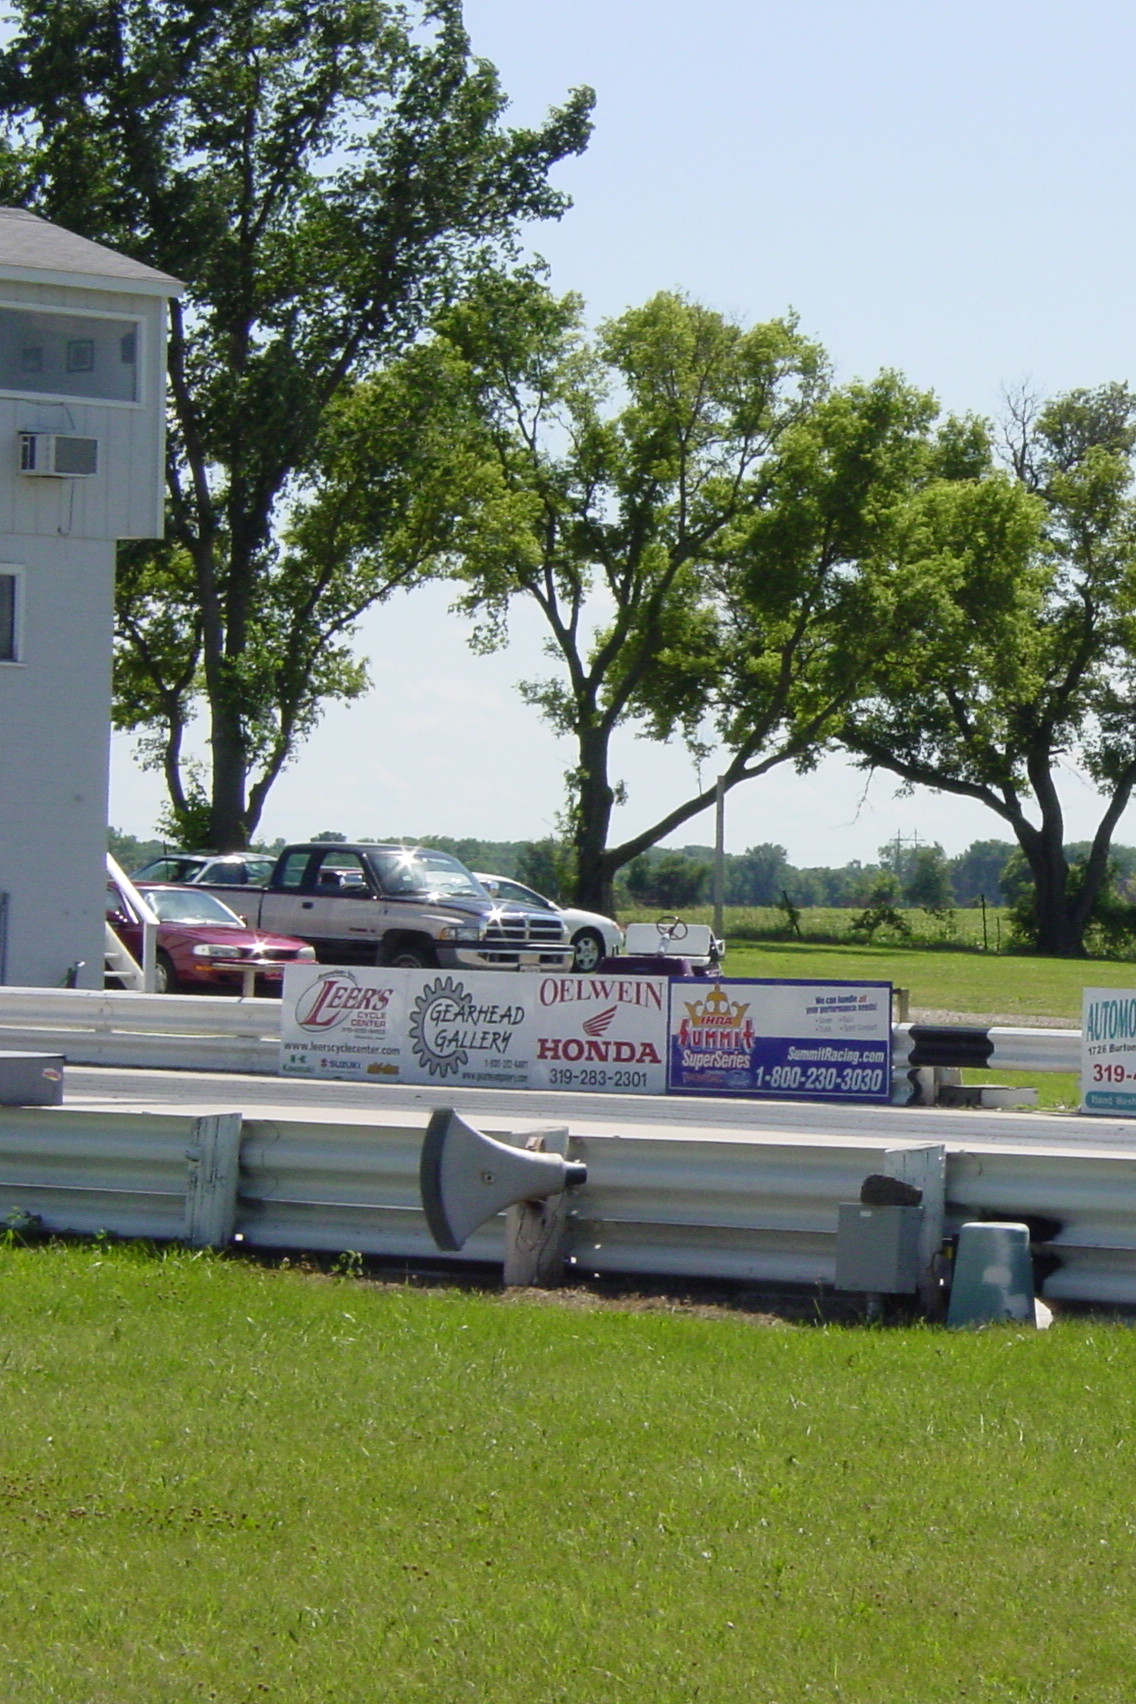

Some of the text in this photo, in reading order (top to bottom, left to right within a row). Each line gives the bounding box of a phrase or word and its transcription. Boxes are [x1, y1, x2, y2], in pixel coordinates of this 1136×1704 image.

[299, 980, 394, 1027] LEER'S
[539, 977, 665, 1012] OELWEIN
[351, 1019, 386, 1028] CENTER
[357, 1012, 386, 1020] CYCLE
[429, 1002, 526, 1027] GEARHEAD
[284, 1041, 401, 1056] www.leerscyclecenter.com
[433, 1028, 514, 1055] GALLERY
[536, 1038, 663, 1065] HONDA
[1109, 1043, 1136, 1053] Burton
[681, 1049, 752, 1071] SuperSeries
[787, 1046, 885, 1065] SummitRacing.com
[549, 1068, 648, 1088] 319-283-2301
[755, 1066, 884, 1092] 1-800-230-3030
